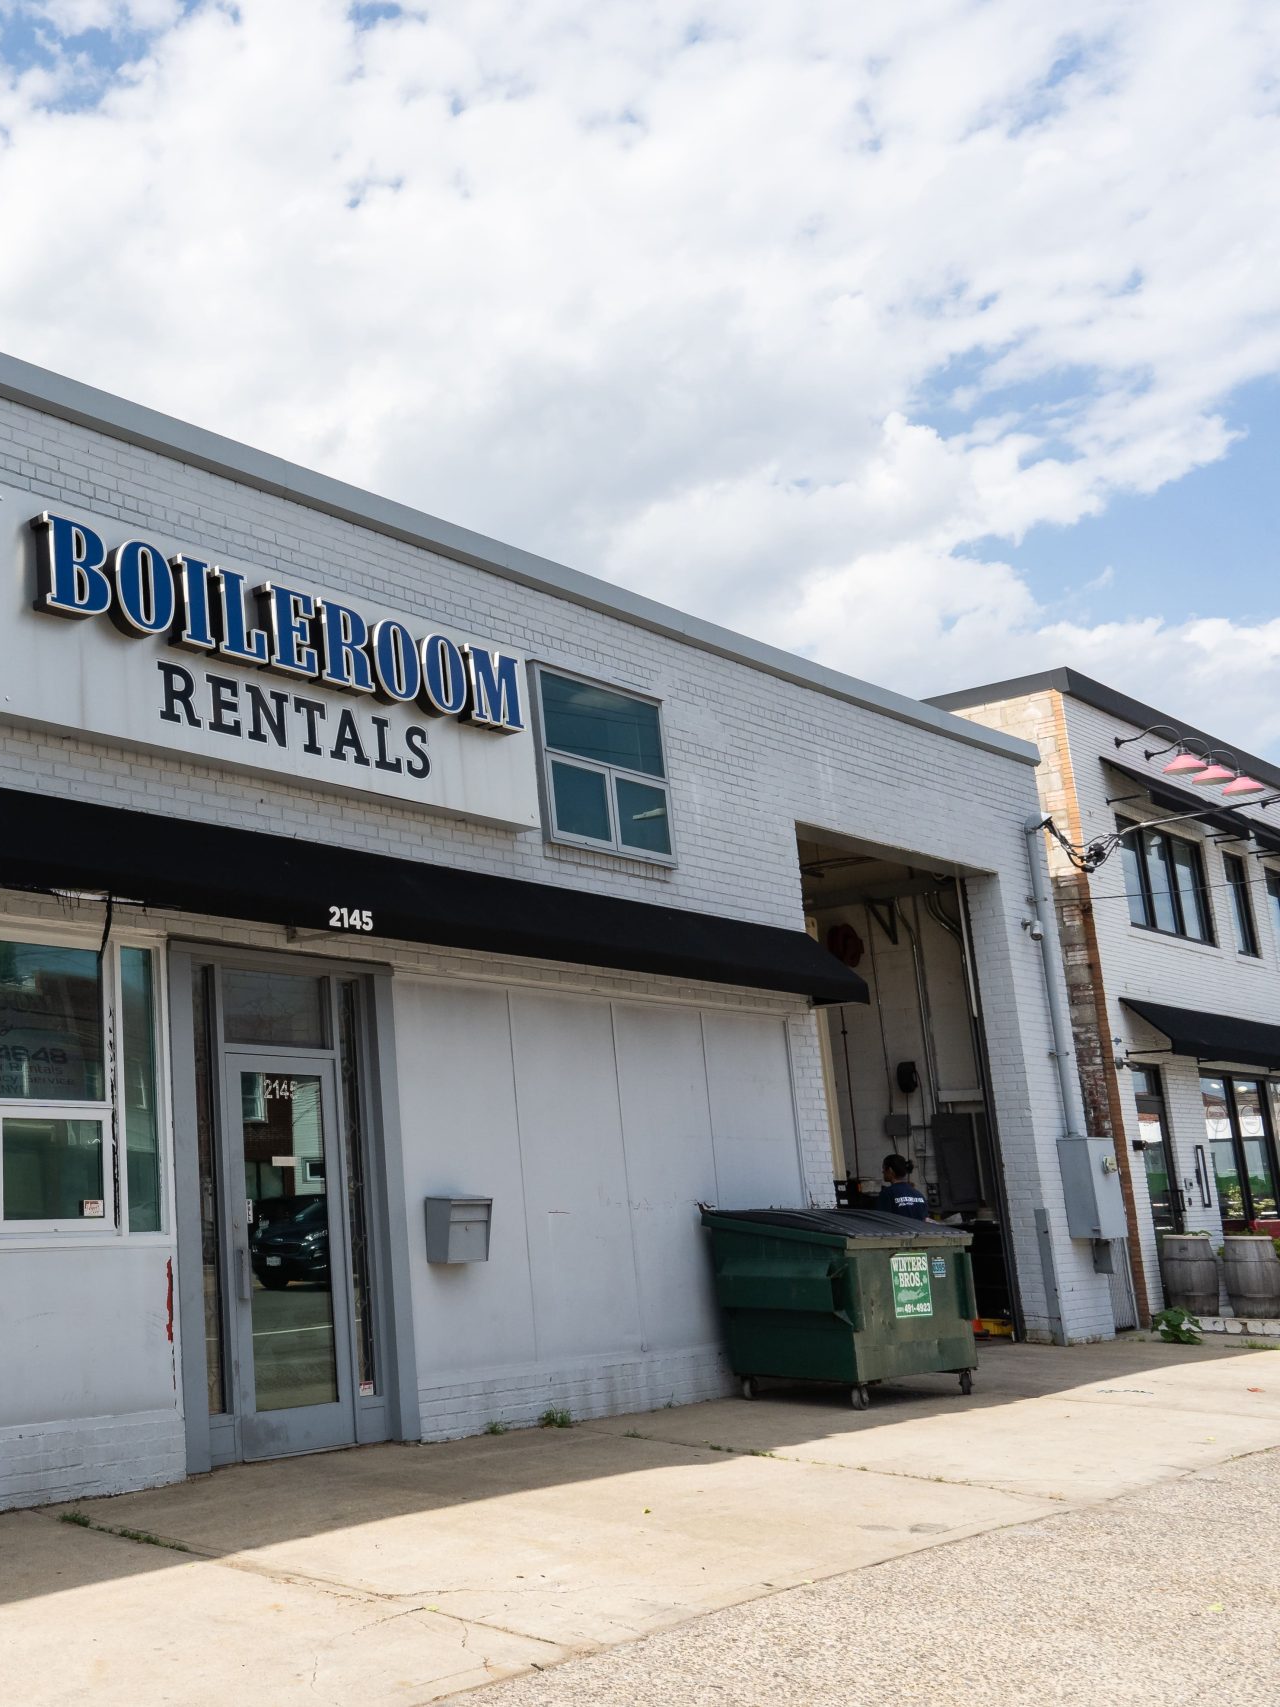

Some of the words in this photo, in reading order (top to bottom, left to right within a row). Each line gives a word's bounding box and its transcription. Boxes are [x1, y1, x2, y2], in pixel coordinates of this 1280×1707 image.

[31, 510, 526, 735] BOILEROOM
[156, 660, 432, 780] RENTALS
[328, 905, 374, 931] 2145
[9, 1062, 64, 1075] Rntals
[263, 1079, 298, 1100] 2145
[891, 1256, 928, 1272] WINTERS
[899, 1271, 924, 1288] BROS.
